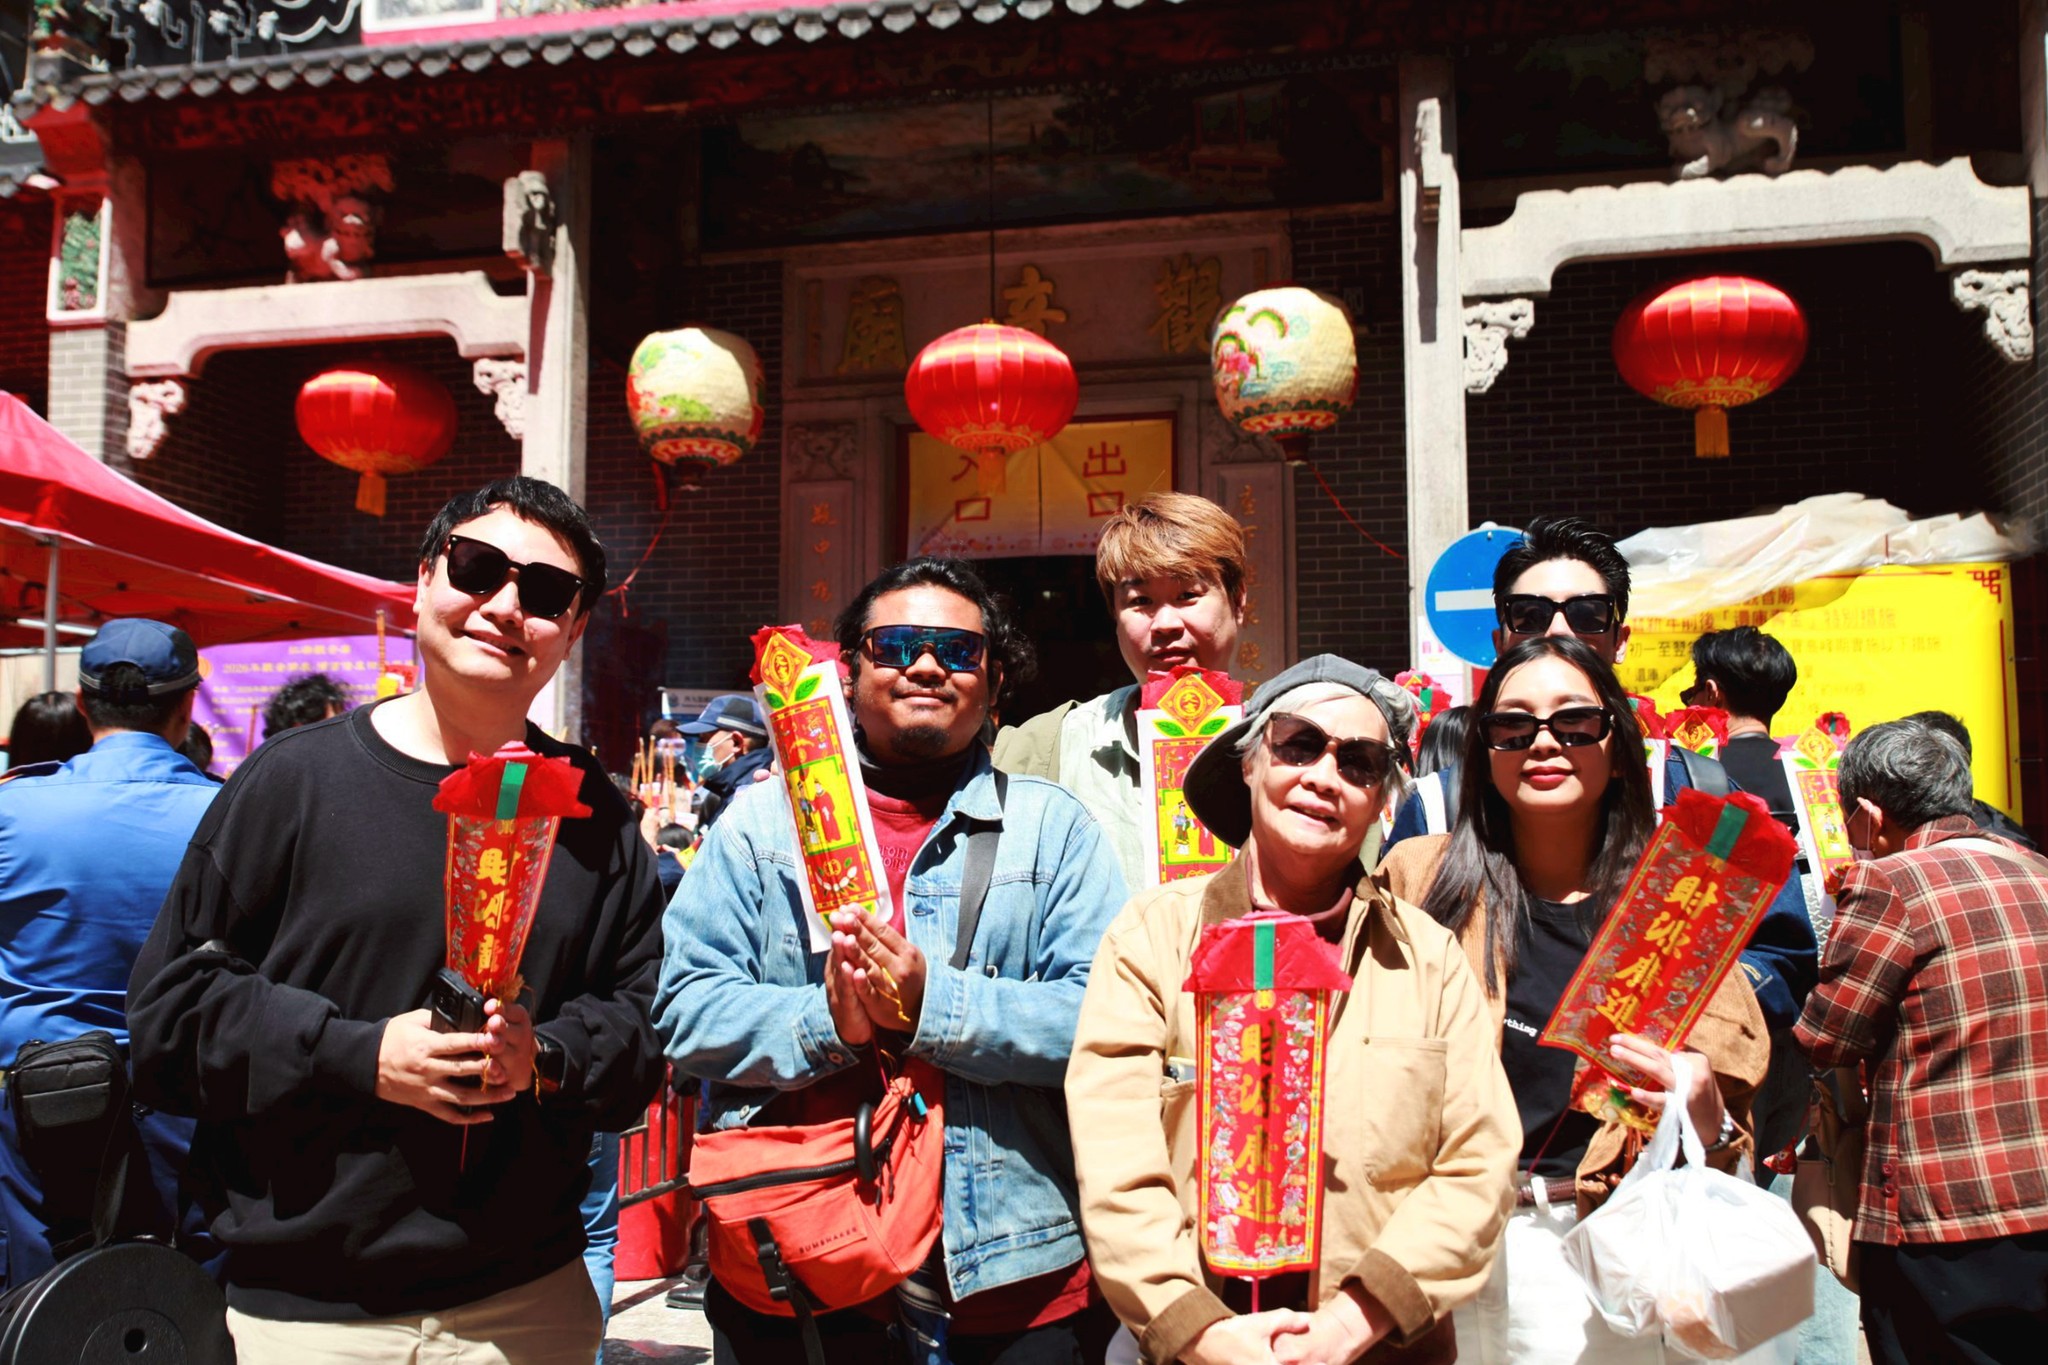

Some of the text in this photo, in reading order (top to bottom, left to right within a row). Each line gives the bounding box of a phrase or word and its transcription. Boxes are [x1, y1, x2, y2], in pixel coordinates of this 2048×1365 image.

[1082, 441, 1127, 517] 出口
[1595, 875, 1718, 1036] 財源廣進
